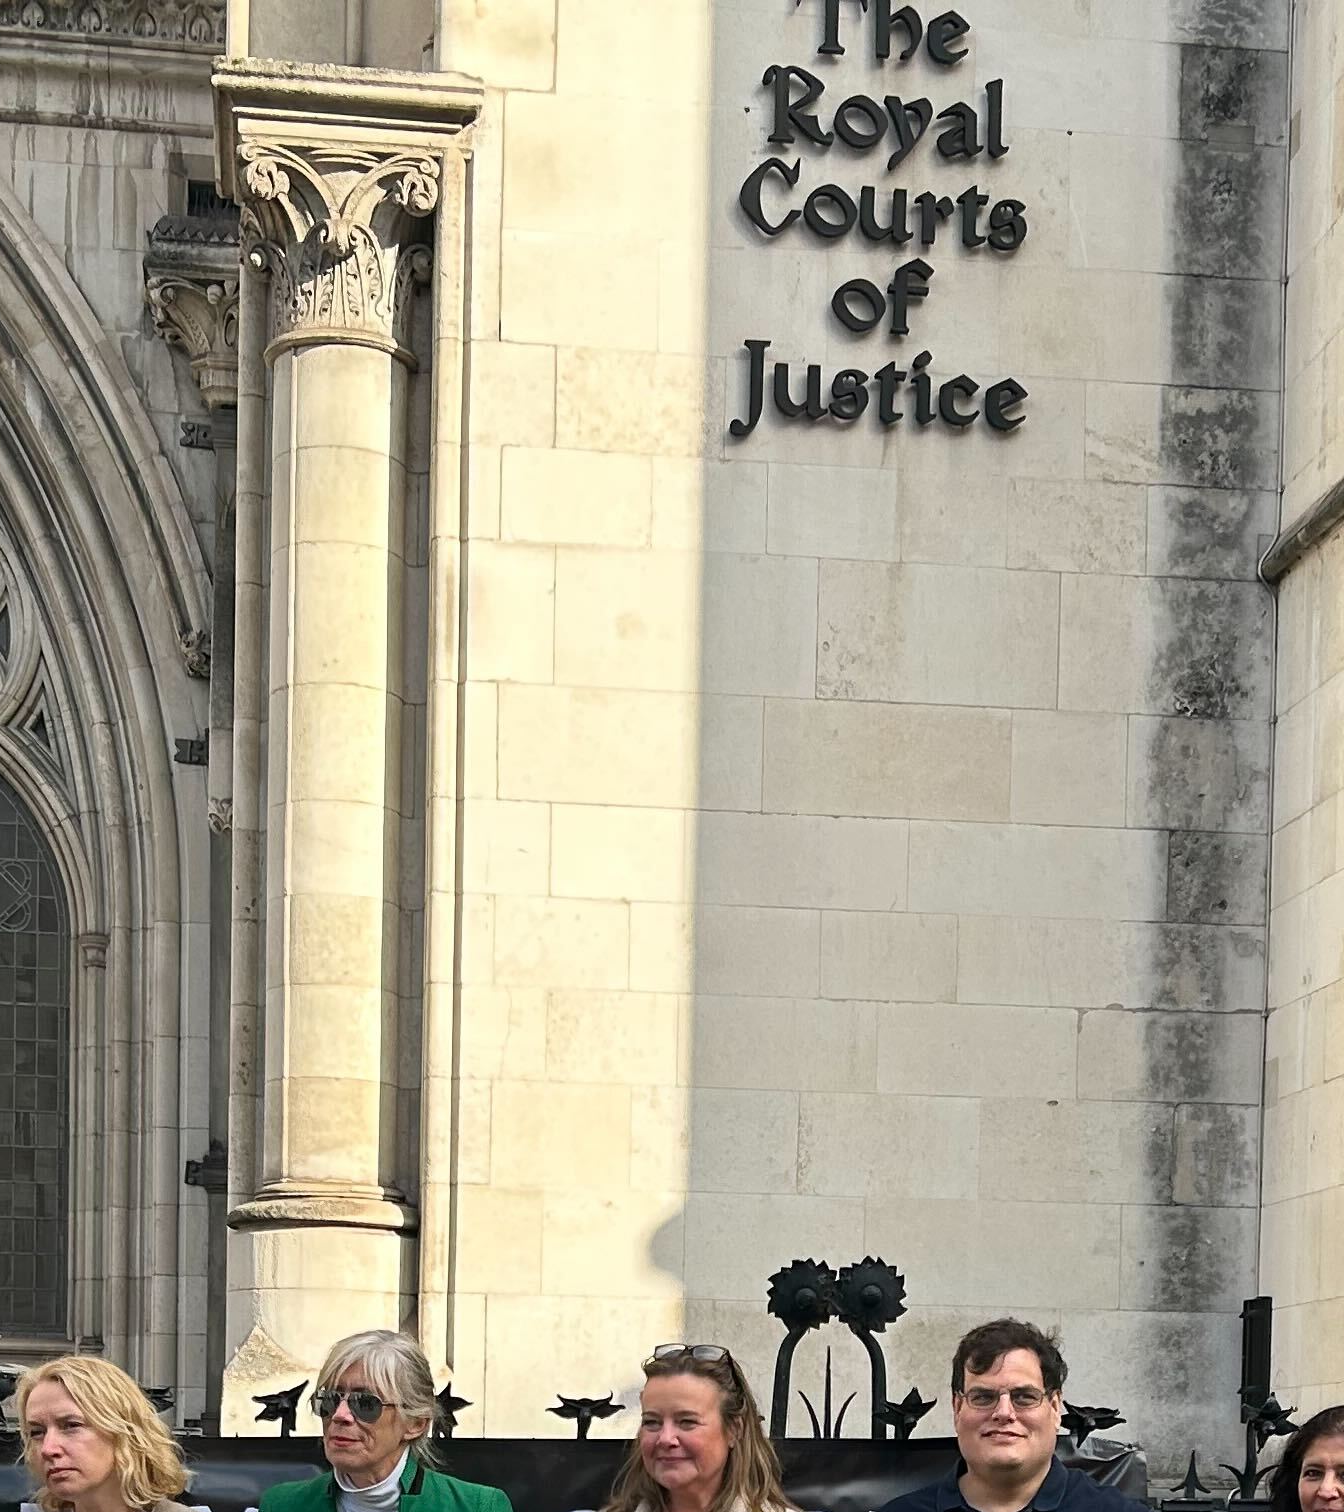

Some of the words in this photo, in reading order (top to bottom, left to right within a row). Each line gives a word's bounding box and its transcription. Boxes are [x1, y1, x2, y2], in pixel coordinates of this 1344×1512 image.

[796, 0, 970, 64] The
[762, 64, 1010, 171] Royal
[739, 157, 1027, 250] Courts
[831, 258, 934, 335] of
[729, 339, 1028, 436] Justice
